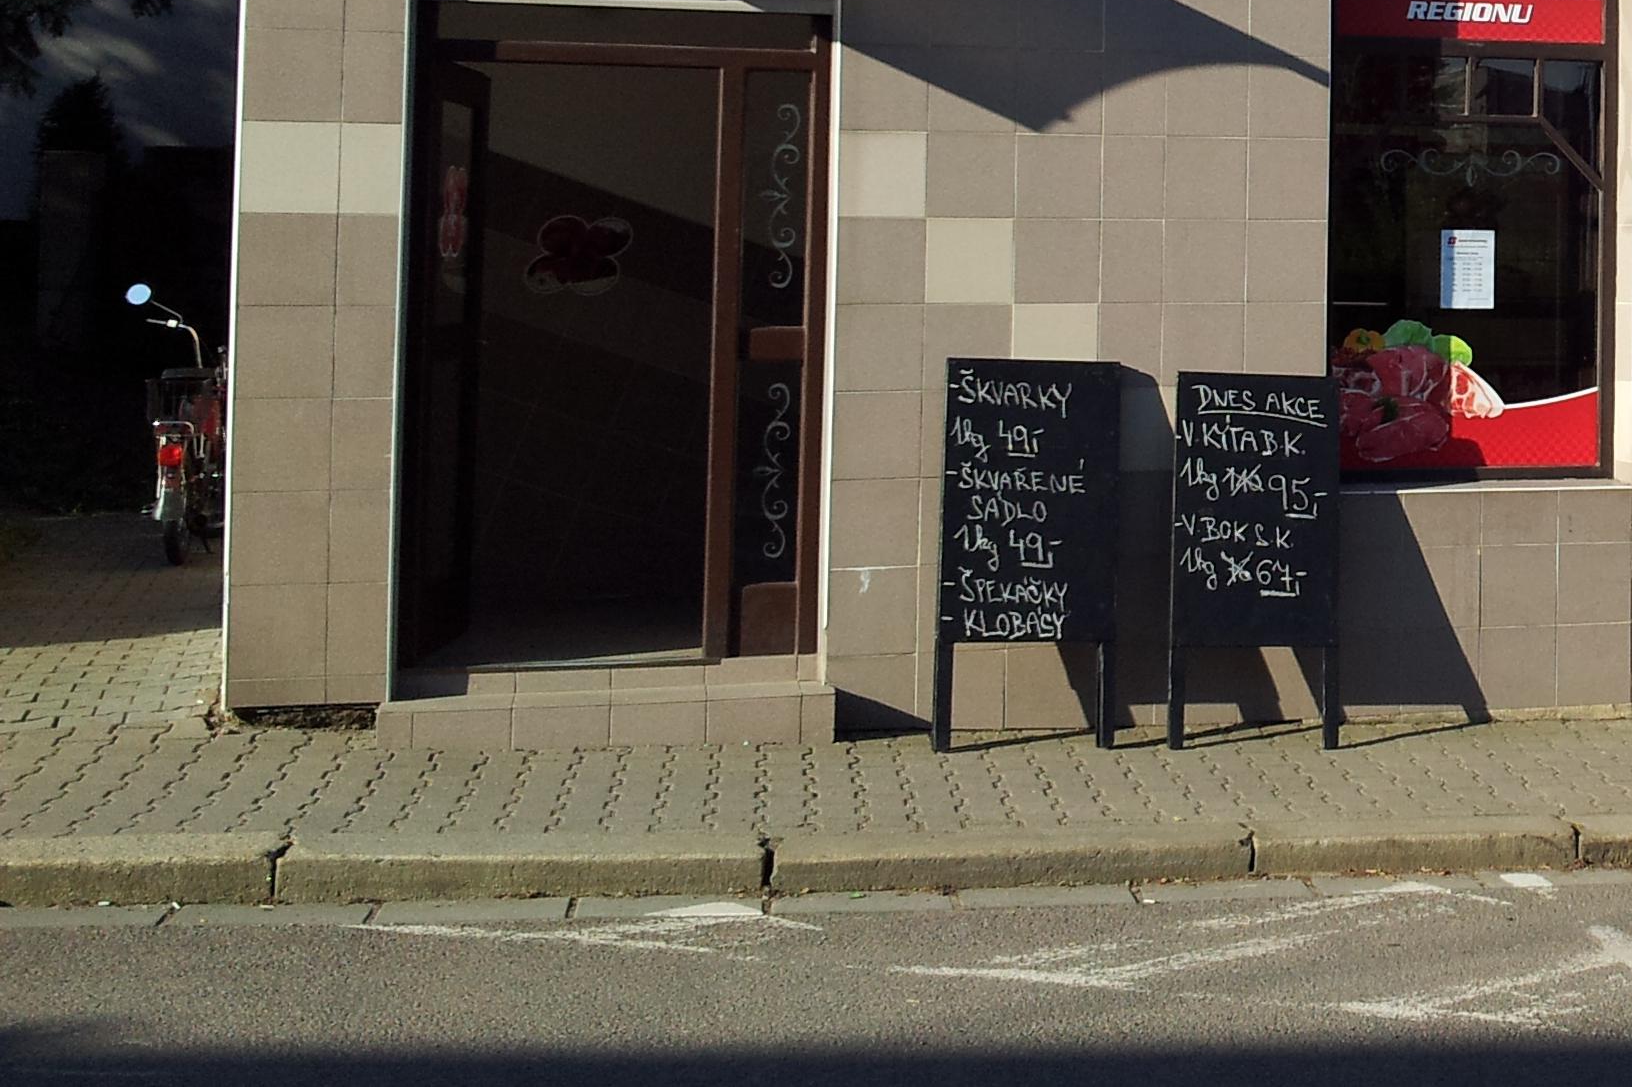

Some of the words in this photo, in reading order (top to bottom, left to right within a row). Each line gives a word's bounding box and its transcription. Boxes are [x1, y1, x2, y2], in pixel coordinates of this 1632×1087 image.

[1406, 0, 1534, 23] REGIONU
[1191, 384, 1256, 411] DNES
[1265, 391, 1325, 419] AKCE
[950, 416, 992, 463] 1kg
[1180, 457, 1220, 501] 1kg
[953, 524, 1000, 572] 1kg
[1180, 547, 1218, 591] 1kg
